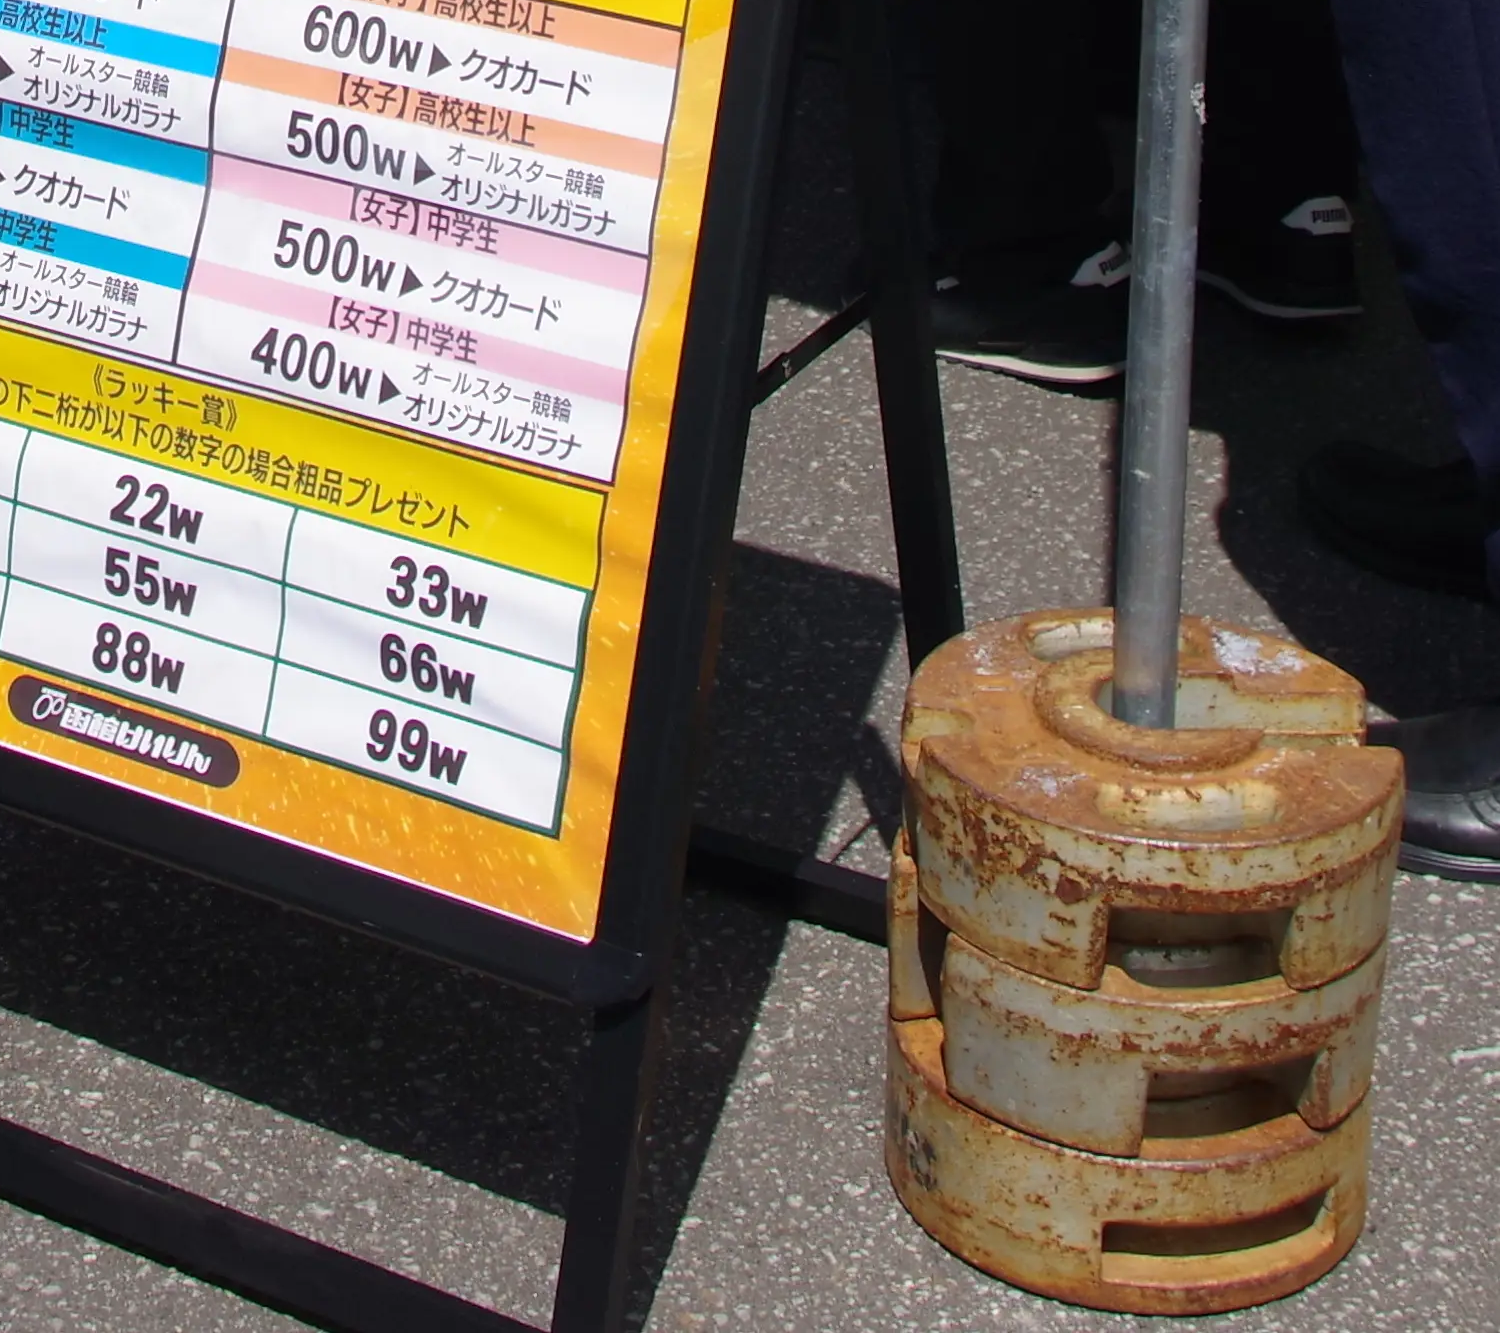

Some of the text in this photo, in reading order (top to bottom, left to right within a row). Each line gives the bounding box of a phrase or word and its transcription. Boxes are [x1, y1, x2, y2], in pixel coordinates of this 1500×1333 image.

[27, 44, 171, 99] オールスター競輪
[460, 47, 594, 107] クオカード
[22, 74, 182, 133] オリジナルガラナ
[12, 163, 131, 221] クオカード
[446, 142, 606, 202] オールスター競輪
[440, 173, 617, 238] オリジナルガラナ
[0, 250, 140, 307] オールスター競輪
[431, 270, 562, 332] クオカード
[412, 361, 573, 424] オールスター競輪
[402, 393, 582, 462] オリジナルガラナ
[59, 702, 212, 774] 函館けいりん
